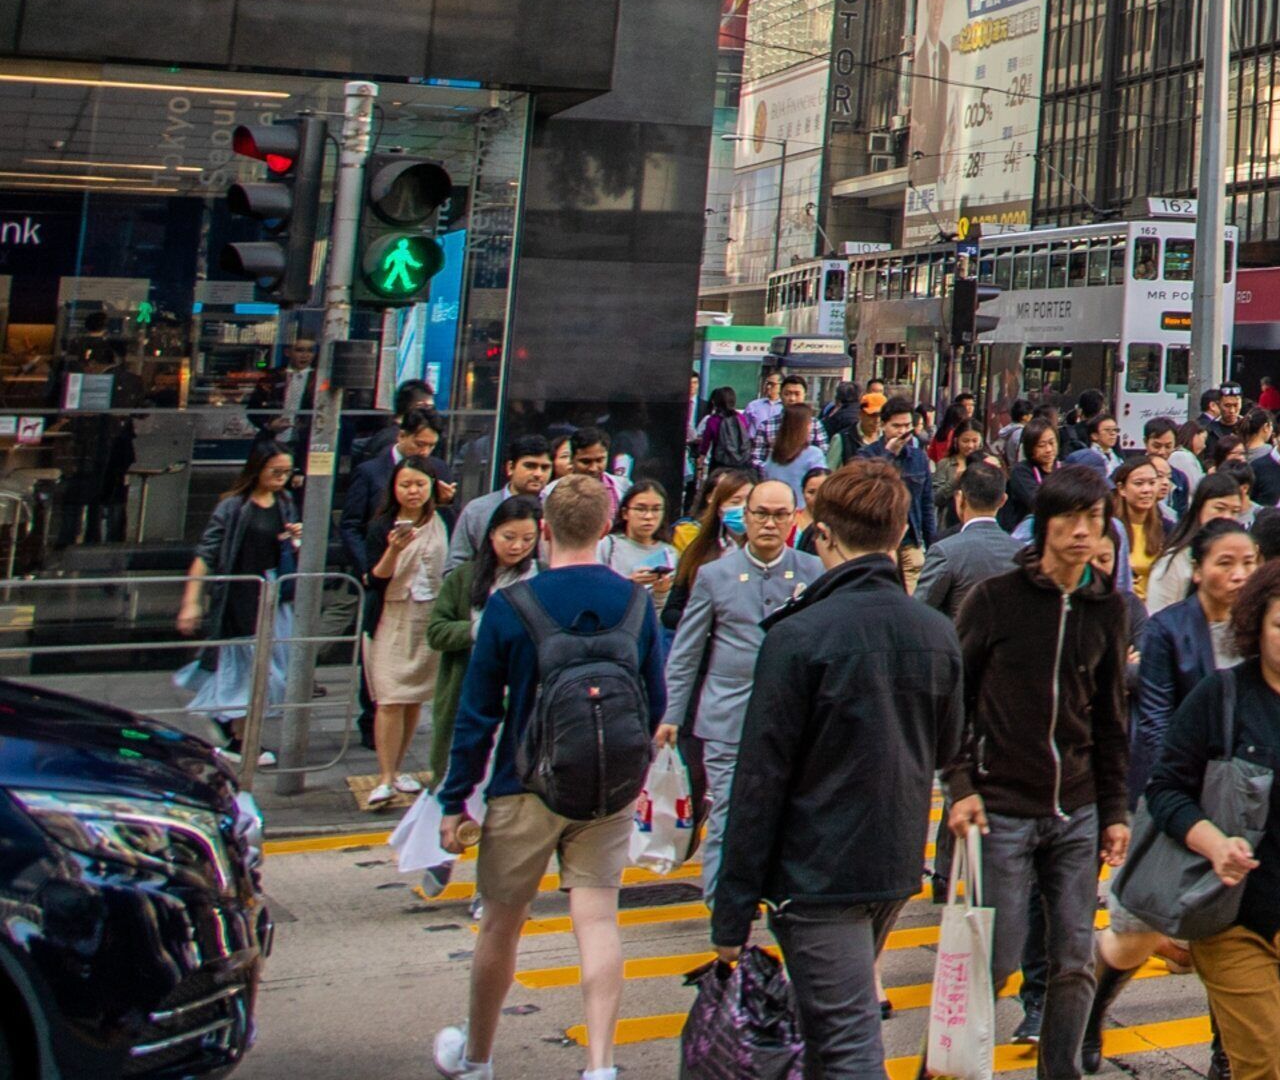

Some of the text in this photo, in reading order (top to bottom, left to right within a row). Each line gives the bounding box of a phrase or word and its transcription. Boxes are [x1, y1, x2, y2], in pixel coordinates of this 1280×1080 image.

[156, 96, 194, 186] Tokyo
[200, 99, 237, 198] Seoul
[1161, 199, 1194, 214] 162
[1140, 226, 1157, 236] 162
[1147, 290, 1167, 300] MR
[1016, 300, 1072, 319] MR PORTER
